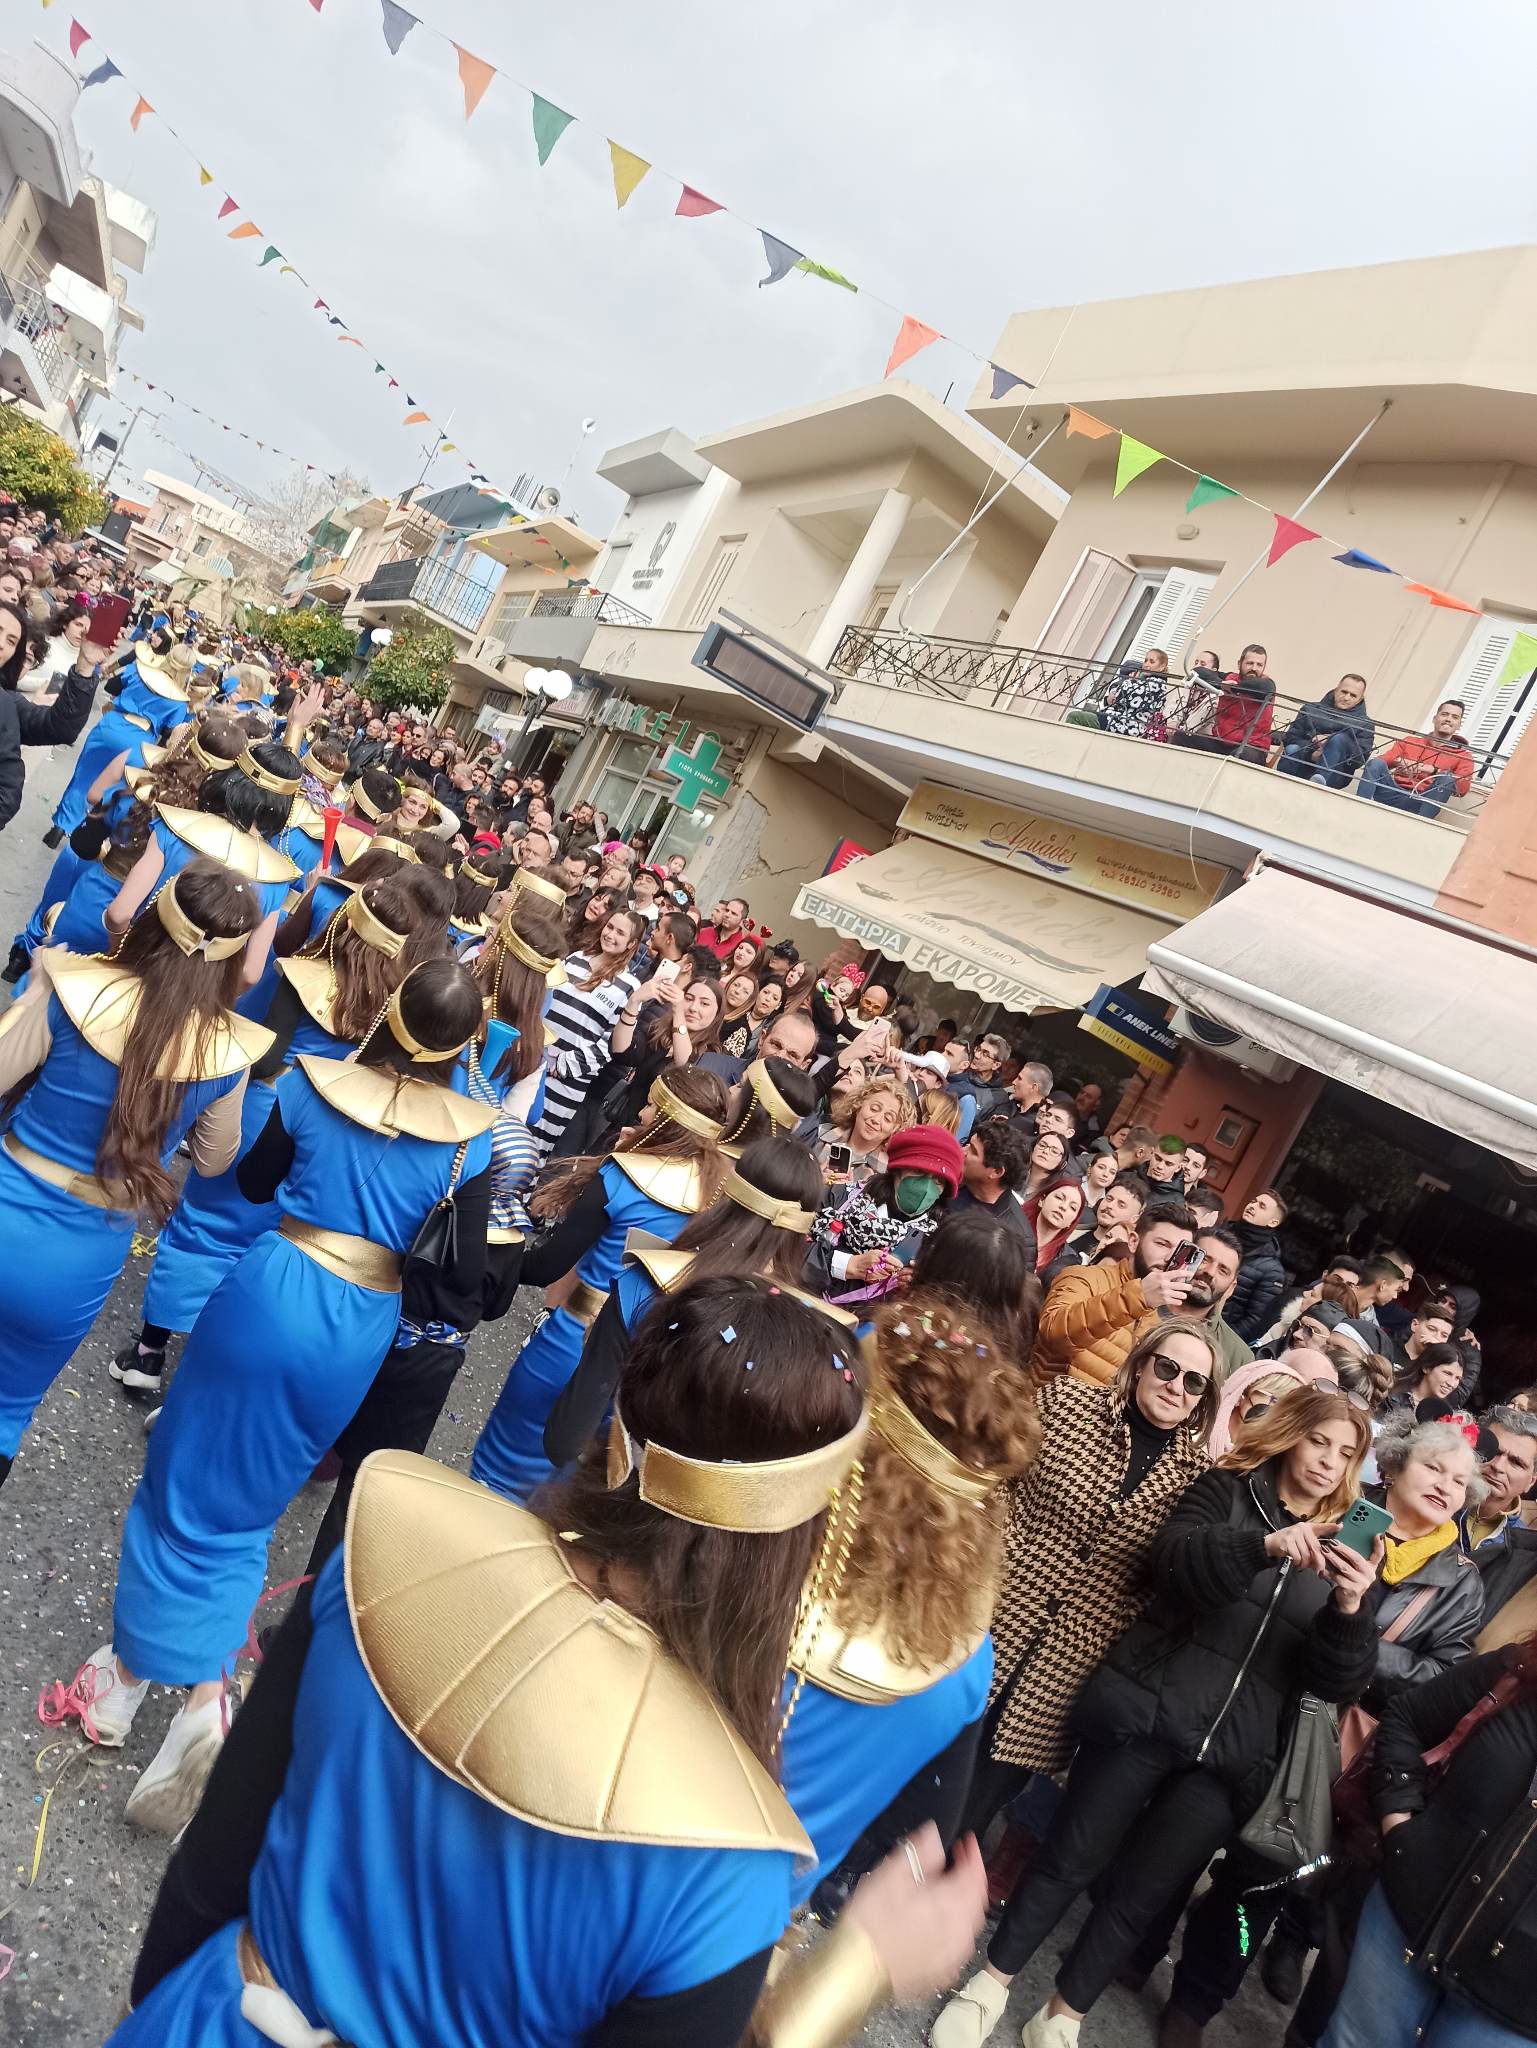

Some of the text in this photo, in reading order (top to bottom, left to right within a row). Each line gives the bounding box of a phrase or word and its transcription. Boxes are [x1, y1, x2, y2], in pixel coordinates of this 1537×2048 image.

[803, 894, 901, 953] ΕΙΣΙΤΗΡΙΑ
[1122, 1013, 1152, 1034] ANEK
[1151, 1029, 1179, 1049] LINES
